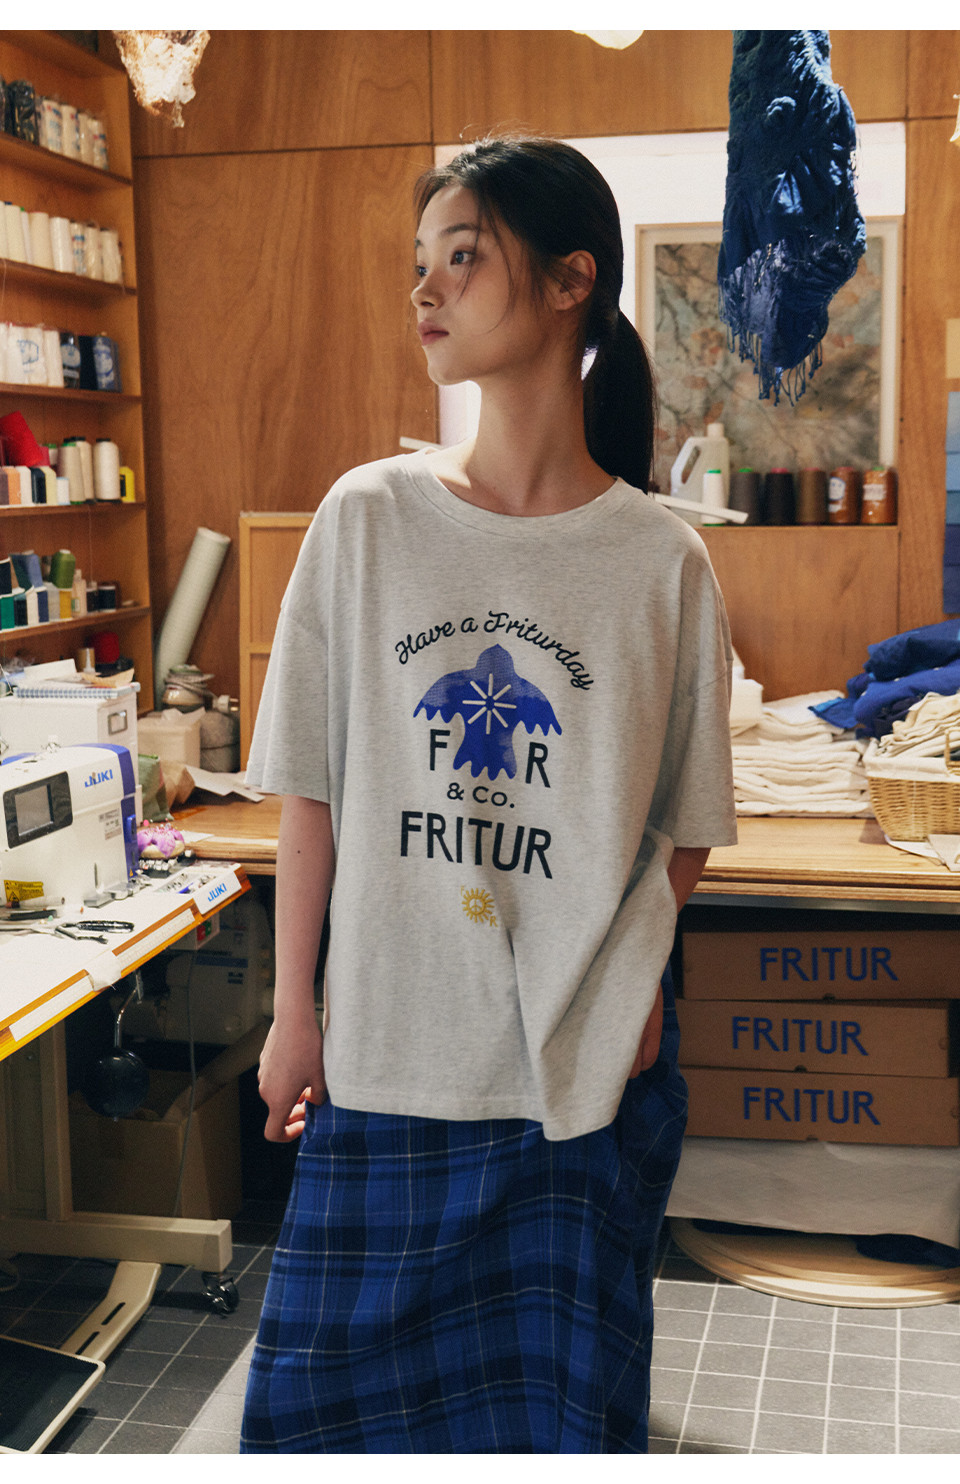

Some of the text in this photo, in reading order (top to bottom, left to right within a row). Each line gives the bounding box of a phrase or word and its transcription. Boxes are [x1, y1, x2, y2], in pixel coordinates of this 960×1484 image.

[394, 610, 594, 691] Have a Friturday
[84, 768, 114, 788] JUKI
[429, 728, 551, 788] F R
[446, 782, 465, 801] &
[400, 810, 553, 880] FRITUR
[207, 882, 228, 902] JUKI
[759, 947, 899, 982] FRITUR
[731, 1016, 869, 1057] FRITUR
[743, 1086, 881, 1126] FRITUR
